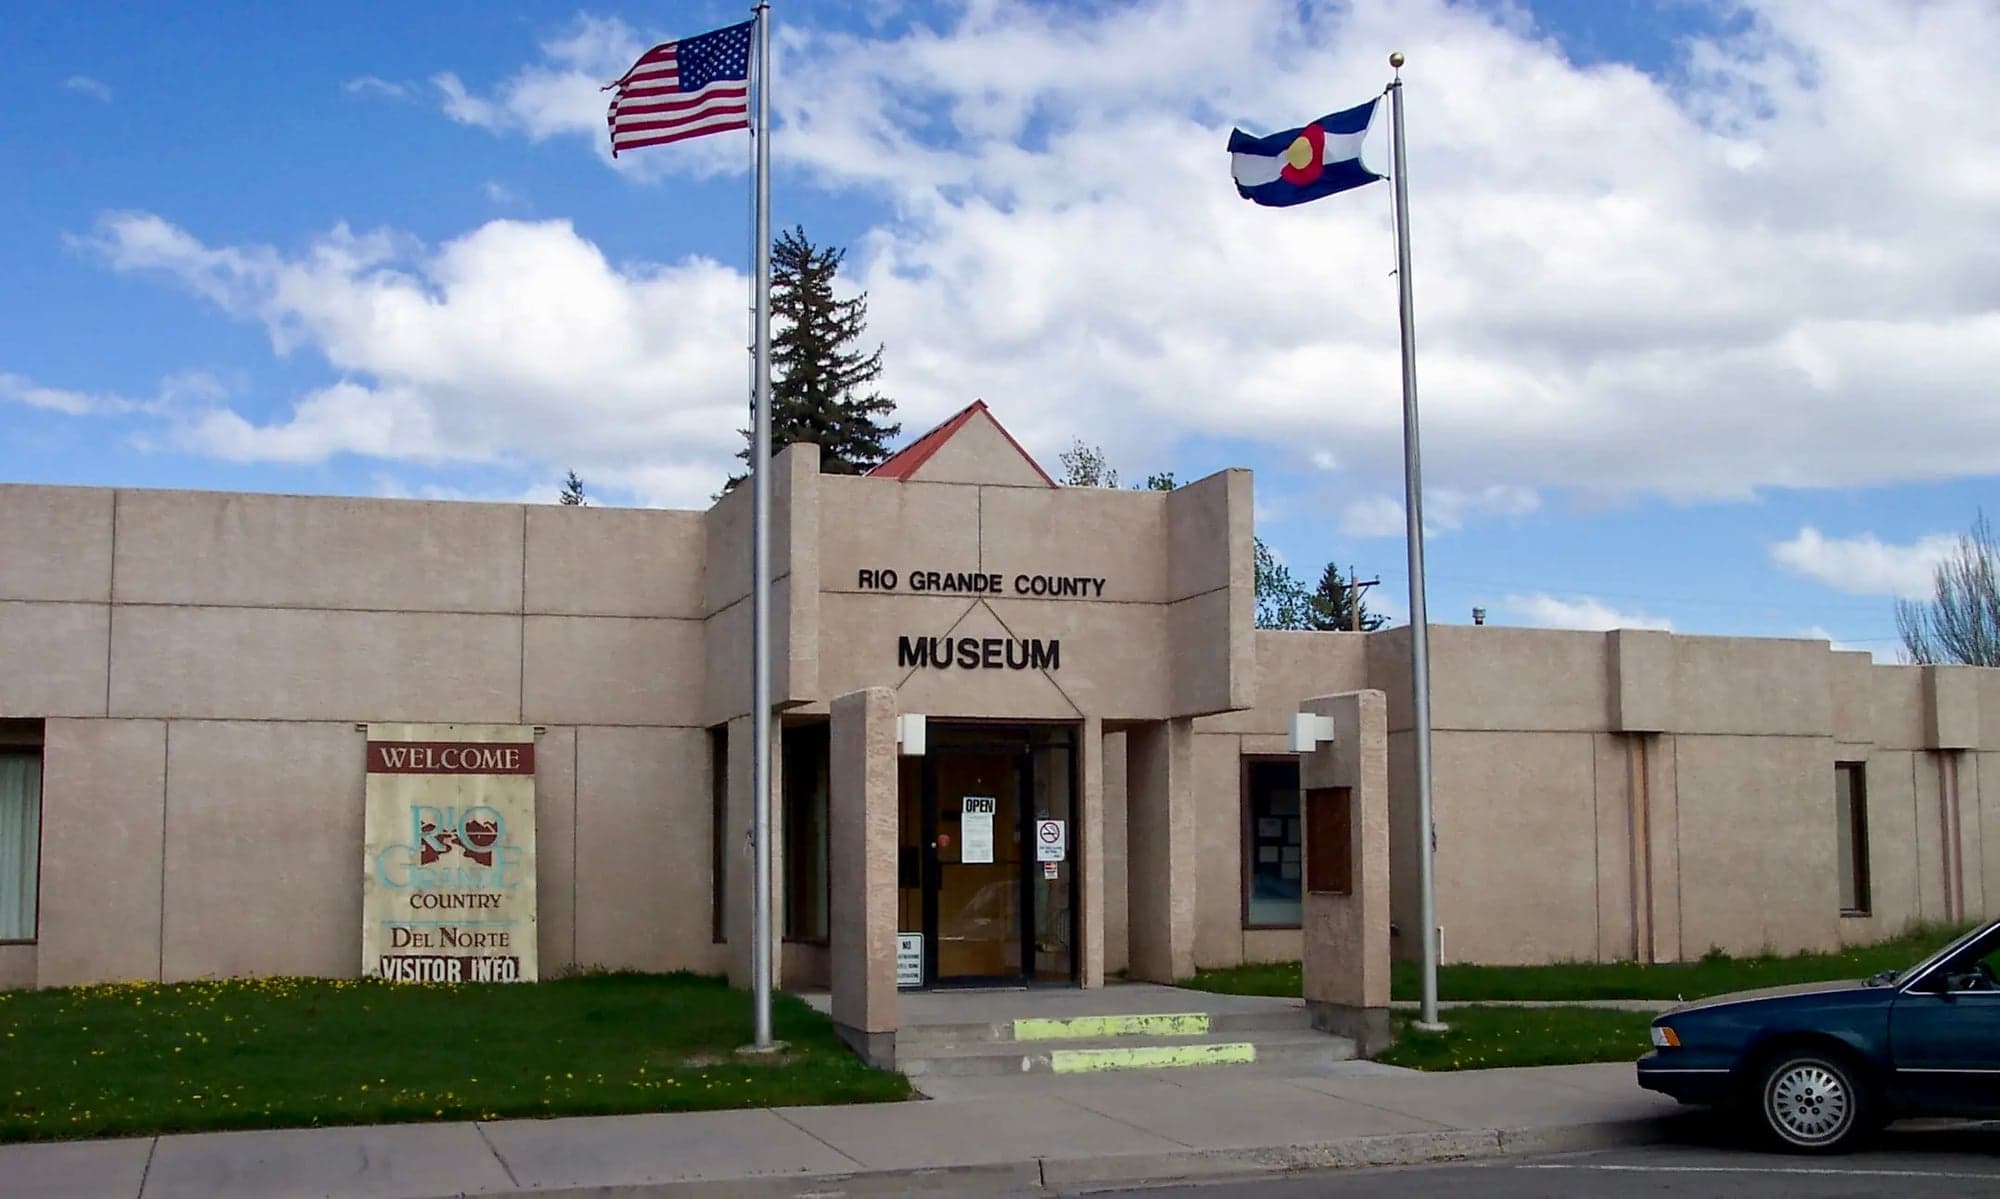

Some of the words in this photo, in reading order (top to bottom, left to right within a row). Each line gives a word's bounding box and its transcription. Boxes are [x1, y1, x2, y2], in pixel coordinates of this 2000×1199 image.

[859, 569, 897, 590] RIO
[909, 571, 1003, 592] GRANDE
[1014, 575, 1106, 596] COUNTY
[898, 636, 1060, 670] MUSEUM
[381, 747, 520, 769] WELCOME
[966, 799, 993, 813] OPEN
[410, 805, 505, 853] RIO
[410, 894, 502, 908] COUNTRY
[391, 927, 434, 947] DEL
[439, 927, 510, 947] NORTE
[382, 958, 461, 982] VISITOR
